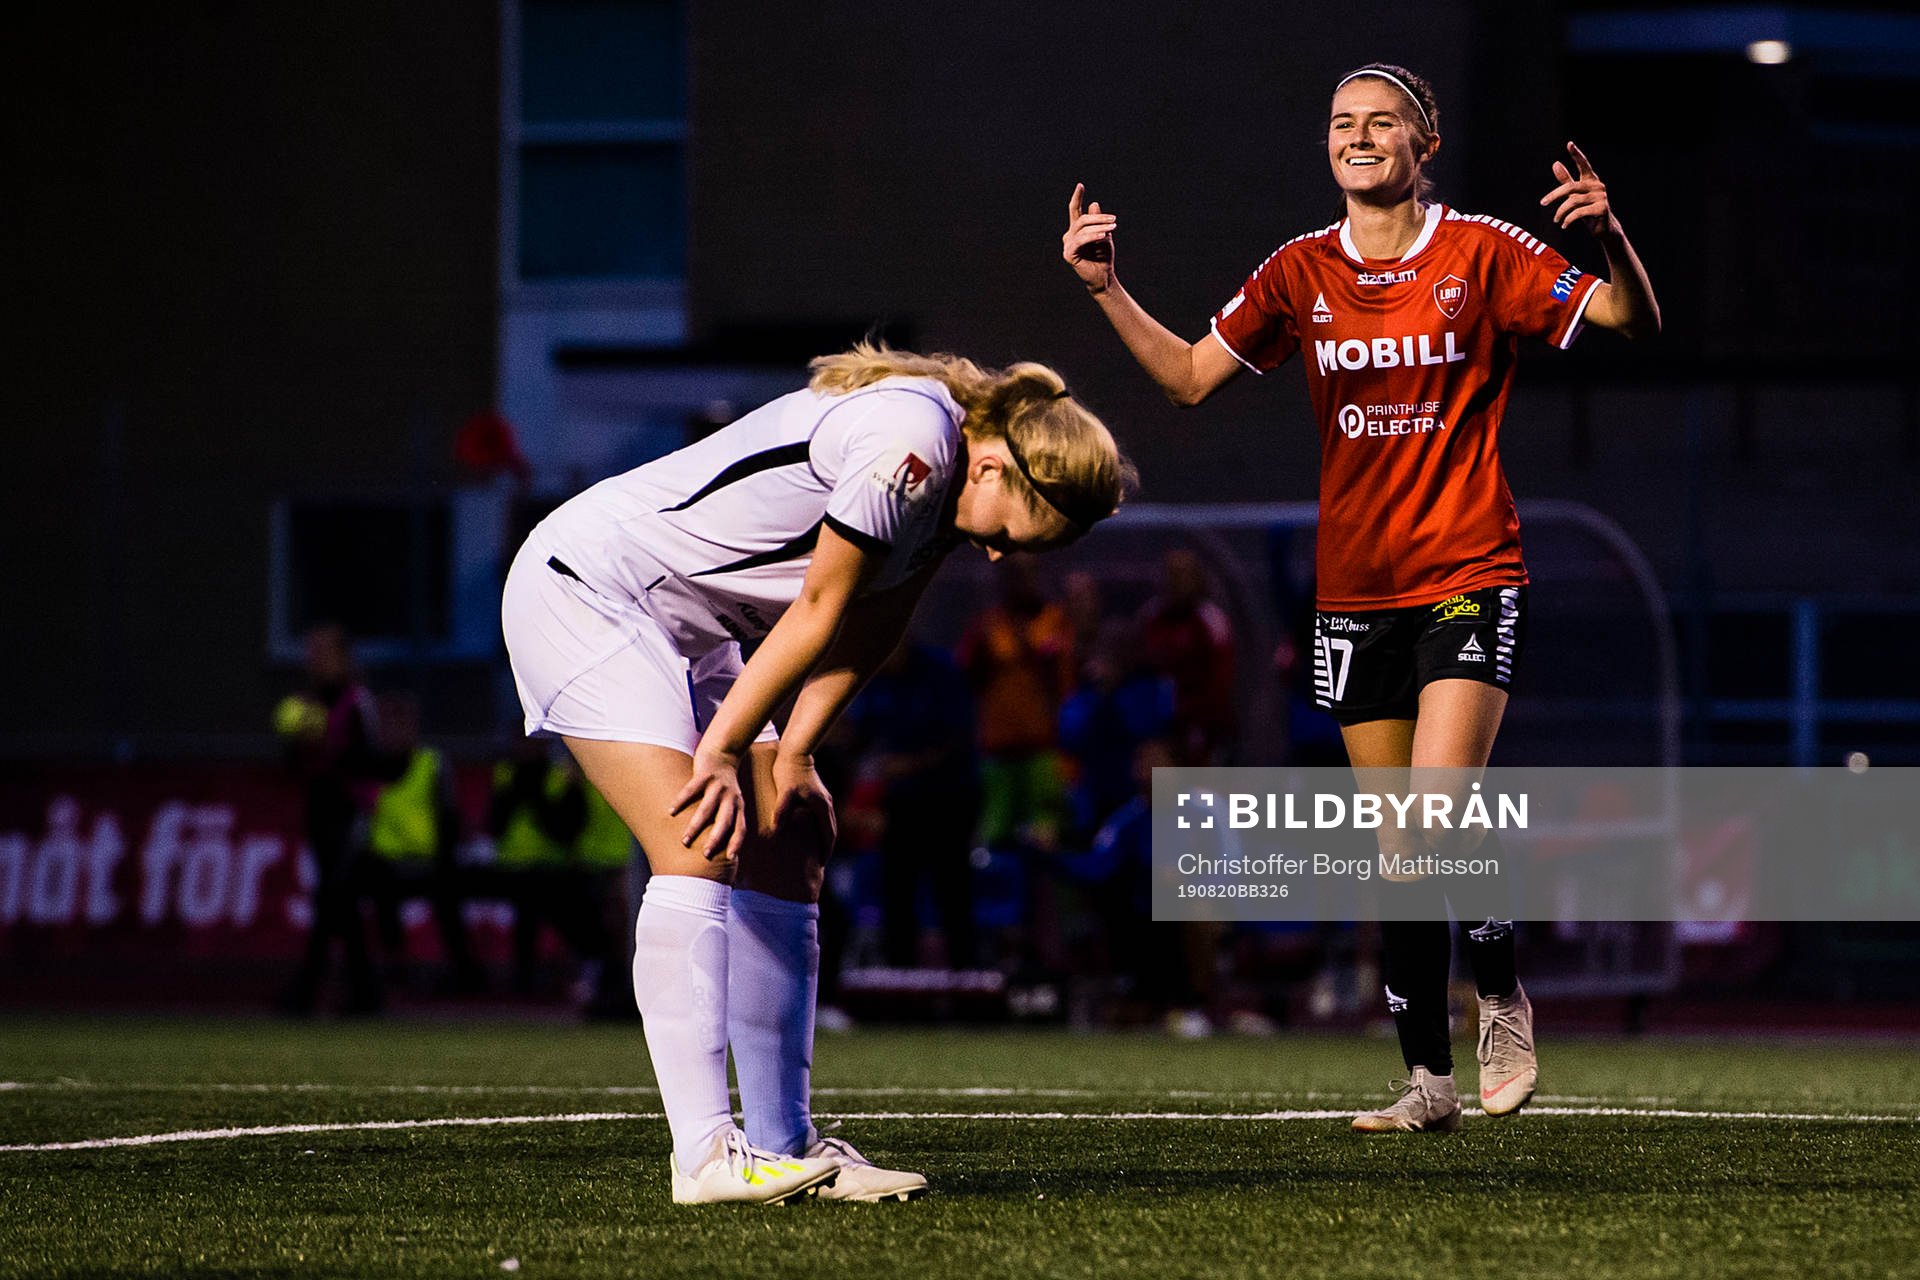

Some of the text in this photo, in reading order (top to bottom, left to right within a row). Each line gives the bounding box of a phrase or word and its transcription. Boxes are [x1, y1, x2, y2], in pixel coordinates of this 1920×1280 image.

[1357, 269, 1417, 286] stadium
[1312, 315, 1333, 323] SELECT
[1315, 332, 1466, 376] MOBILL
[1366, 417, 1446, 437] ELECTRA
[1457, 652, 1486, 663] SELECT
[1322, 636, 1354, 702] 17
[138, 798, 285, 928] för
